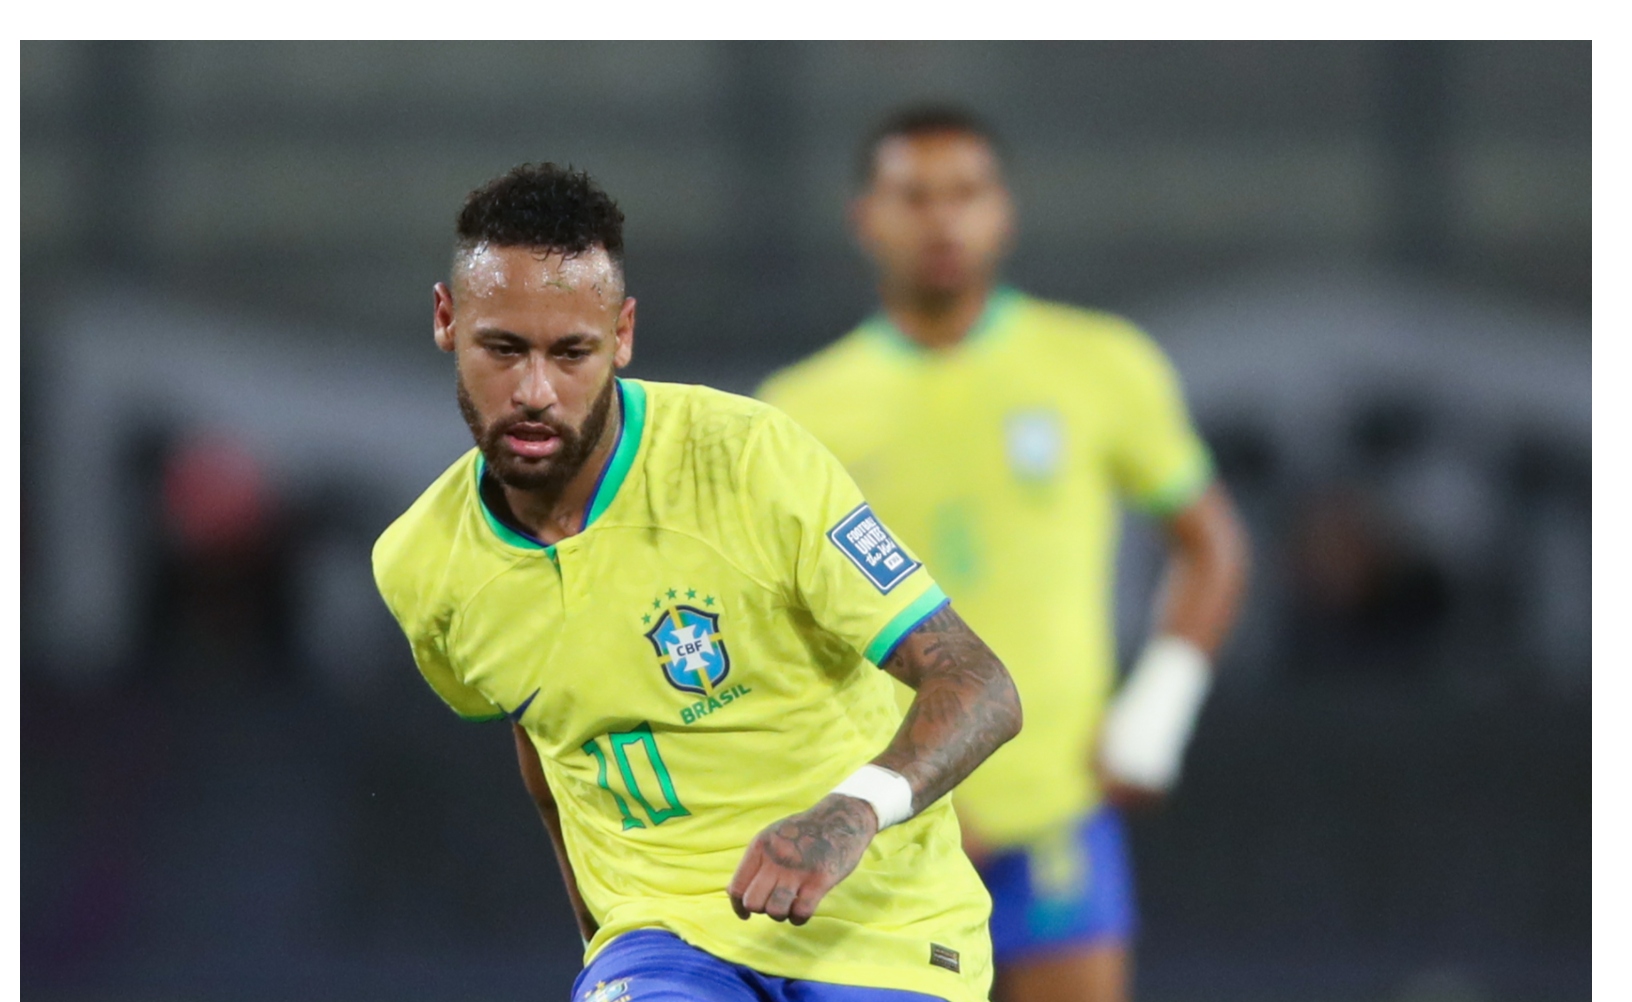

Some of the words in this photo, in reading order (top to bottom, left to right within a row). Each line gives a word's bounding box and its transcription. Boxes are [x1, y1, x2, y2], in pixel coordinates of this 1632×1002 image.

[854, 526, 887, 555] UNITES
[676, 640, 703, 657] CBF
[679, 684, 753, 726] BRASIL
[580, 719, 692, 832] 10
